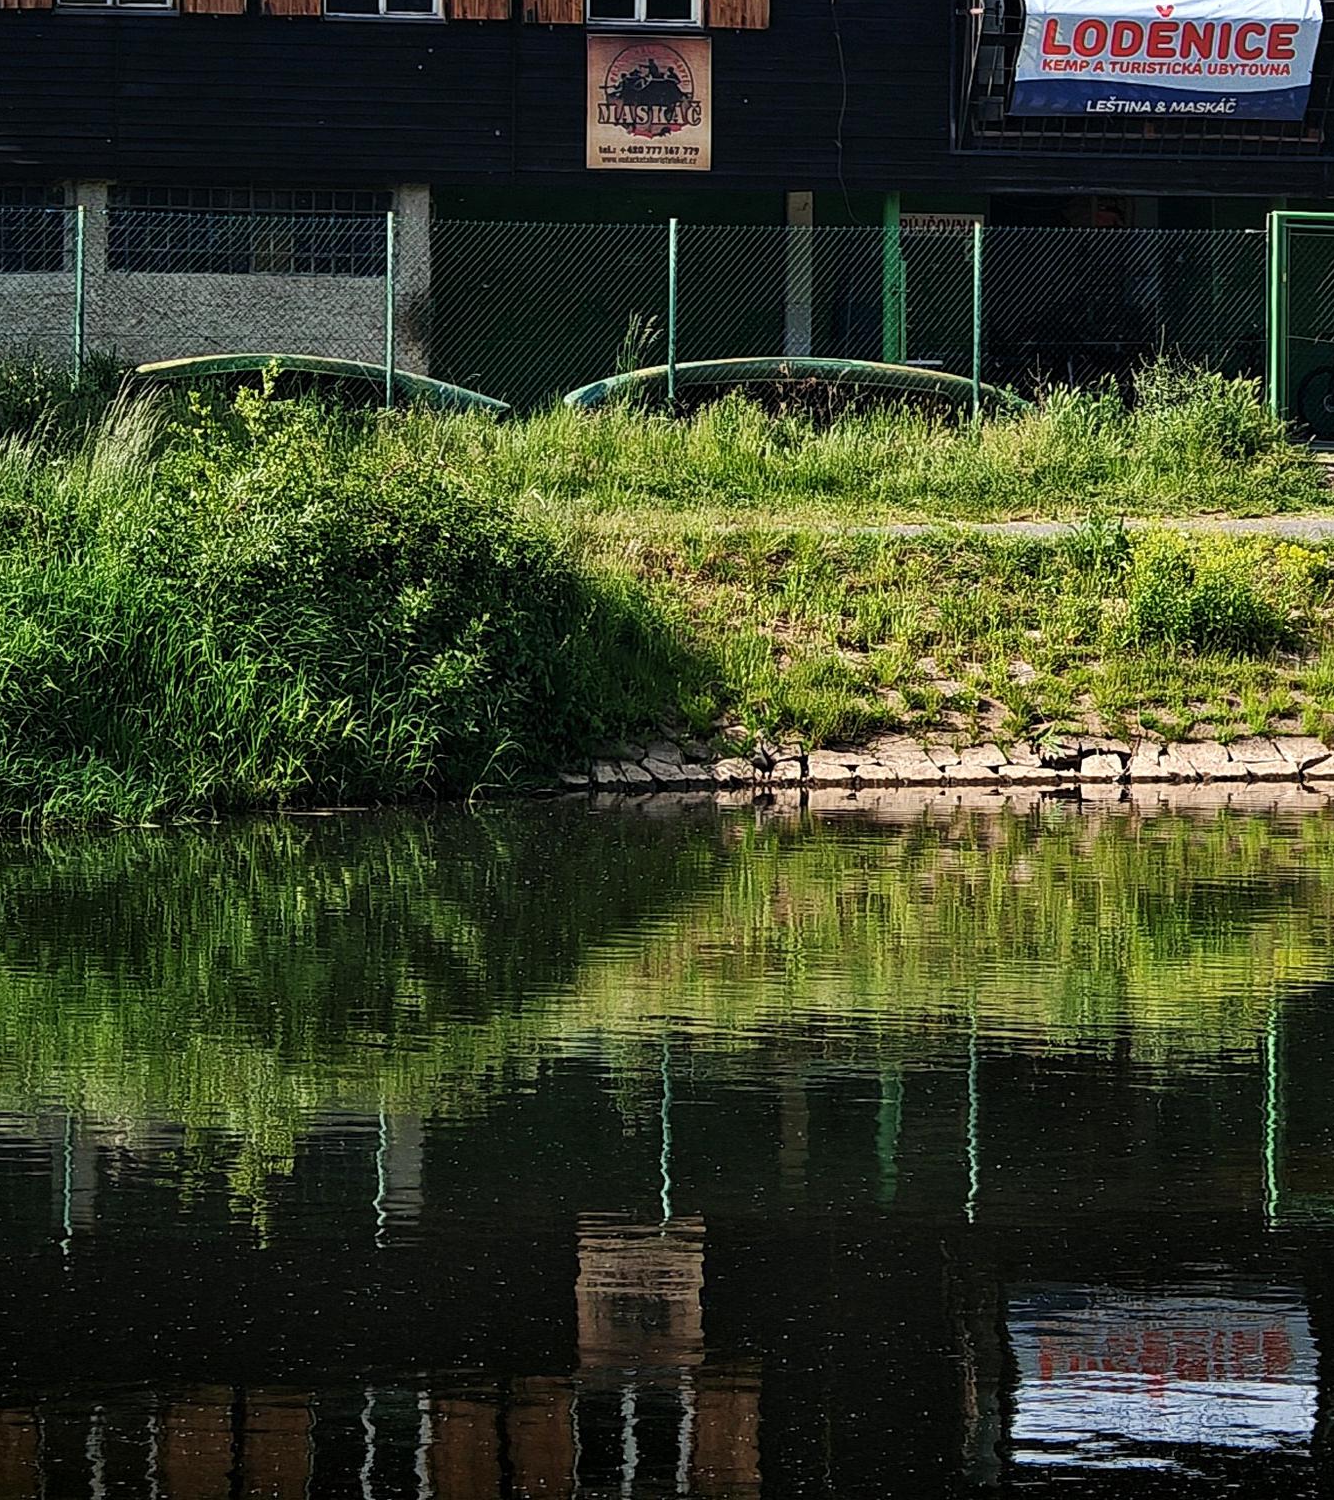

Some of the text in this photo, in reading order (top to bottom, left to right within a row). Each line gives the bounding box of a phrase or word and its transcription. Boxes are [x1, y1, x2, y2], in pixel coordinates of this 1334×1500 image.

[1042, 4, 1300, 60] LODĚNICE
[1042, 56, 1290, 76] KEMP A TURISTICKÁ UBYTOVNA
[597, 100, 702, 126] MASKÁČ
[1087, 96, 1237, 114] LEŠTINA & MASKÁČ
[646, 146, 662, 154] 777
